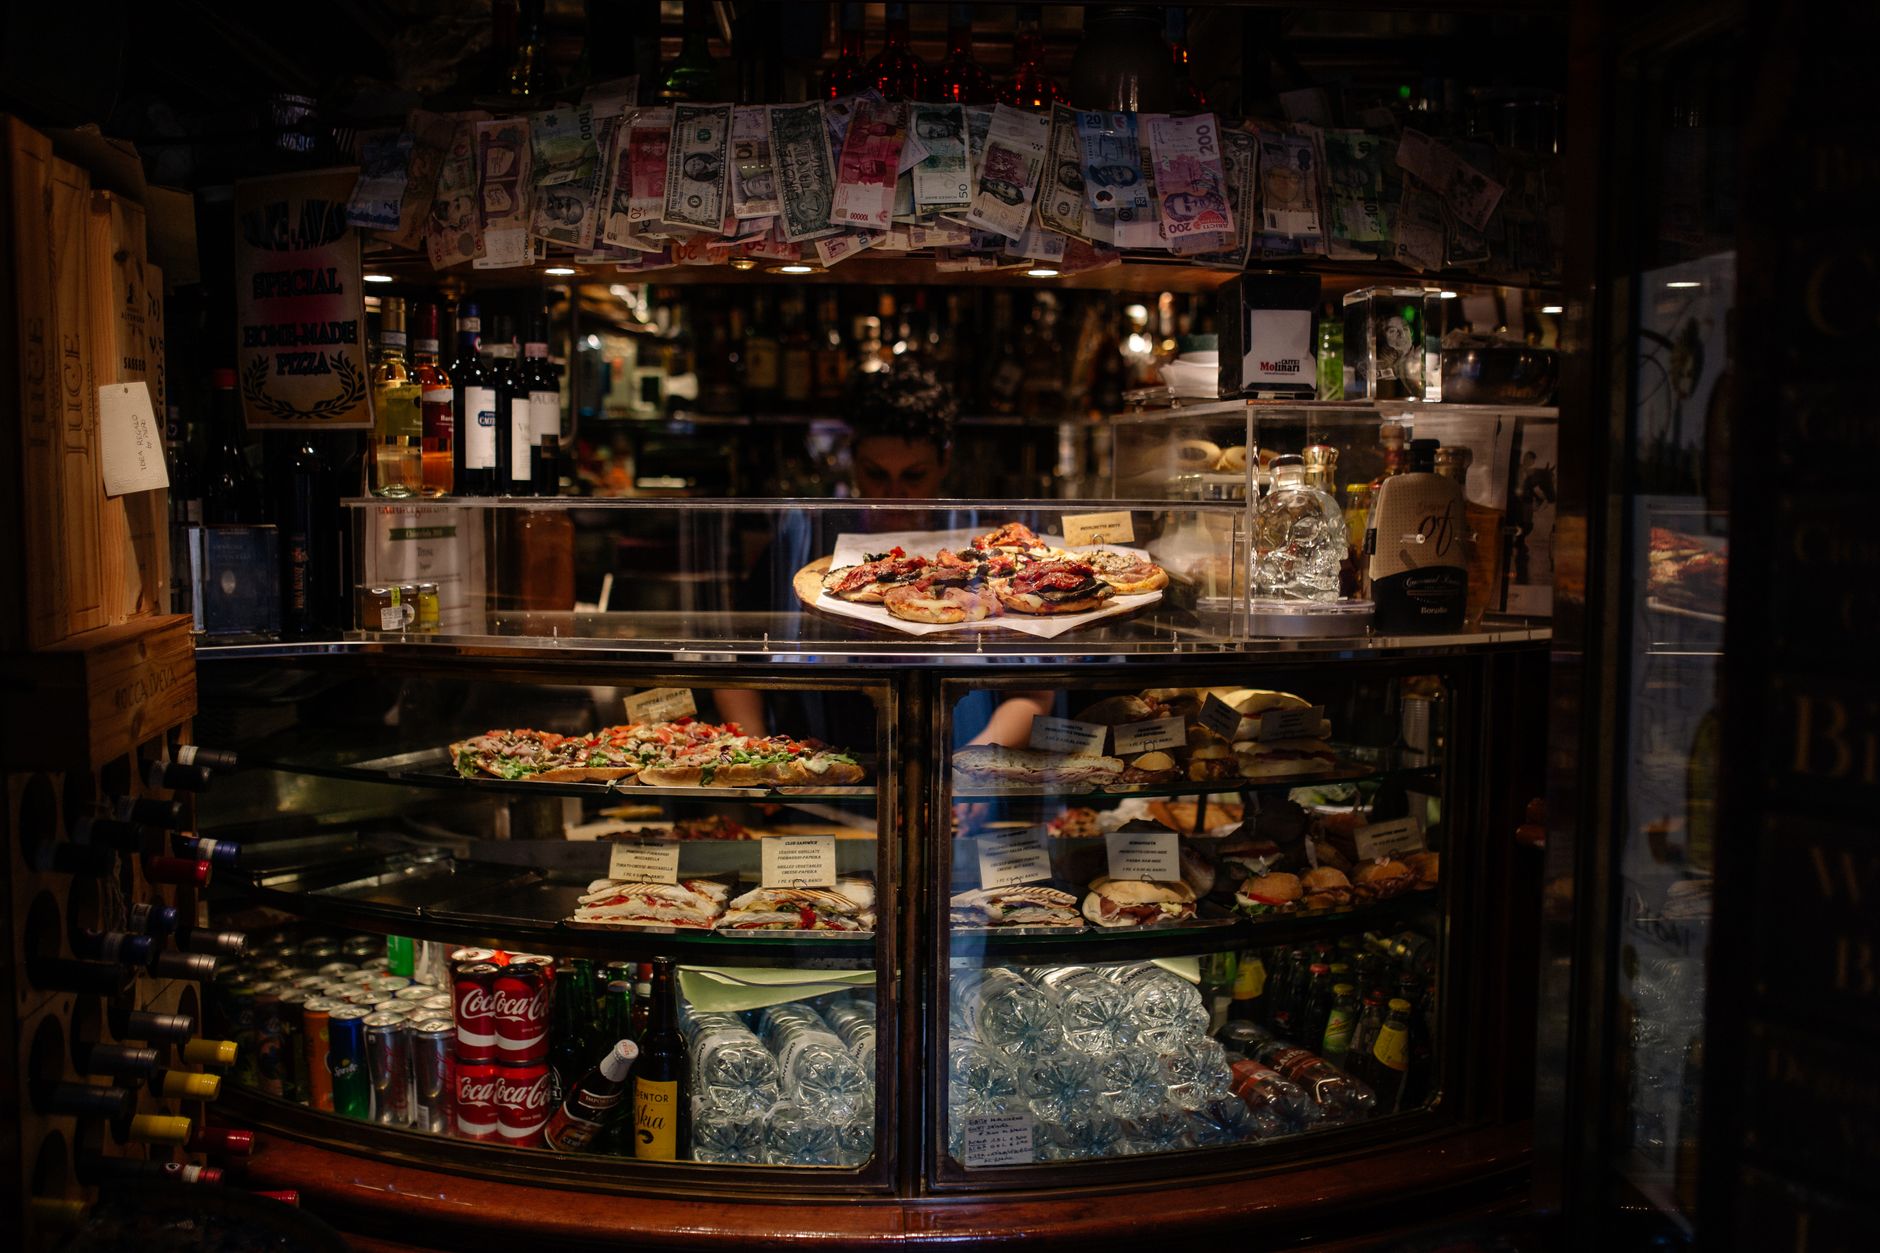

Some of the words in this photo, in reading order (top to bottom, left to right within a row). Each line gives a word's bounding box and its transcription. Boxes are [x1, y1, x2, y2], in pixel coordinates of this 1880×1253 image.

[578, 111, 593, 141] 1000
[1086, 114, 1102, 125] 20
[1196, 124, 1214, 155] 200
[959, 183, 968, 199] 50
[384, 201, 392, 211] 2
[1168, 222, 1192, 234] 200
[253, 267, 343, 300] SPECIAL
[243, 320, 357, 347] HOME-MADE
[276, 351, 331, 376] PIZZA
[1260, 361, 1300, 372] Molinari
[63, 333, 89, 456] LUCE
[1417, 499, 1456, 557] of
[636, 1090, 670, 1103] ENTOR
